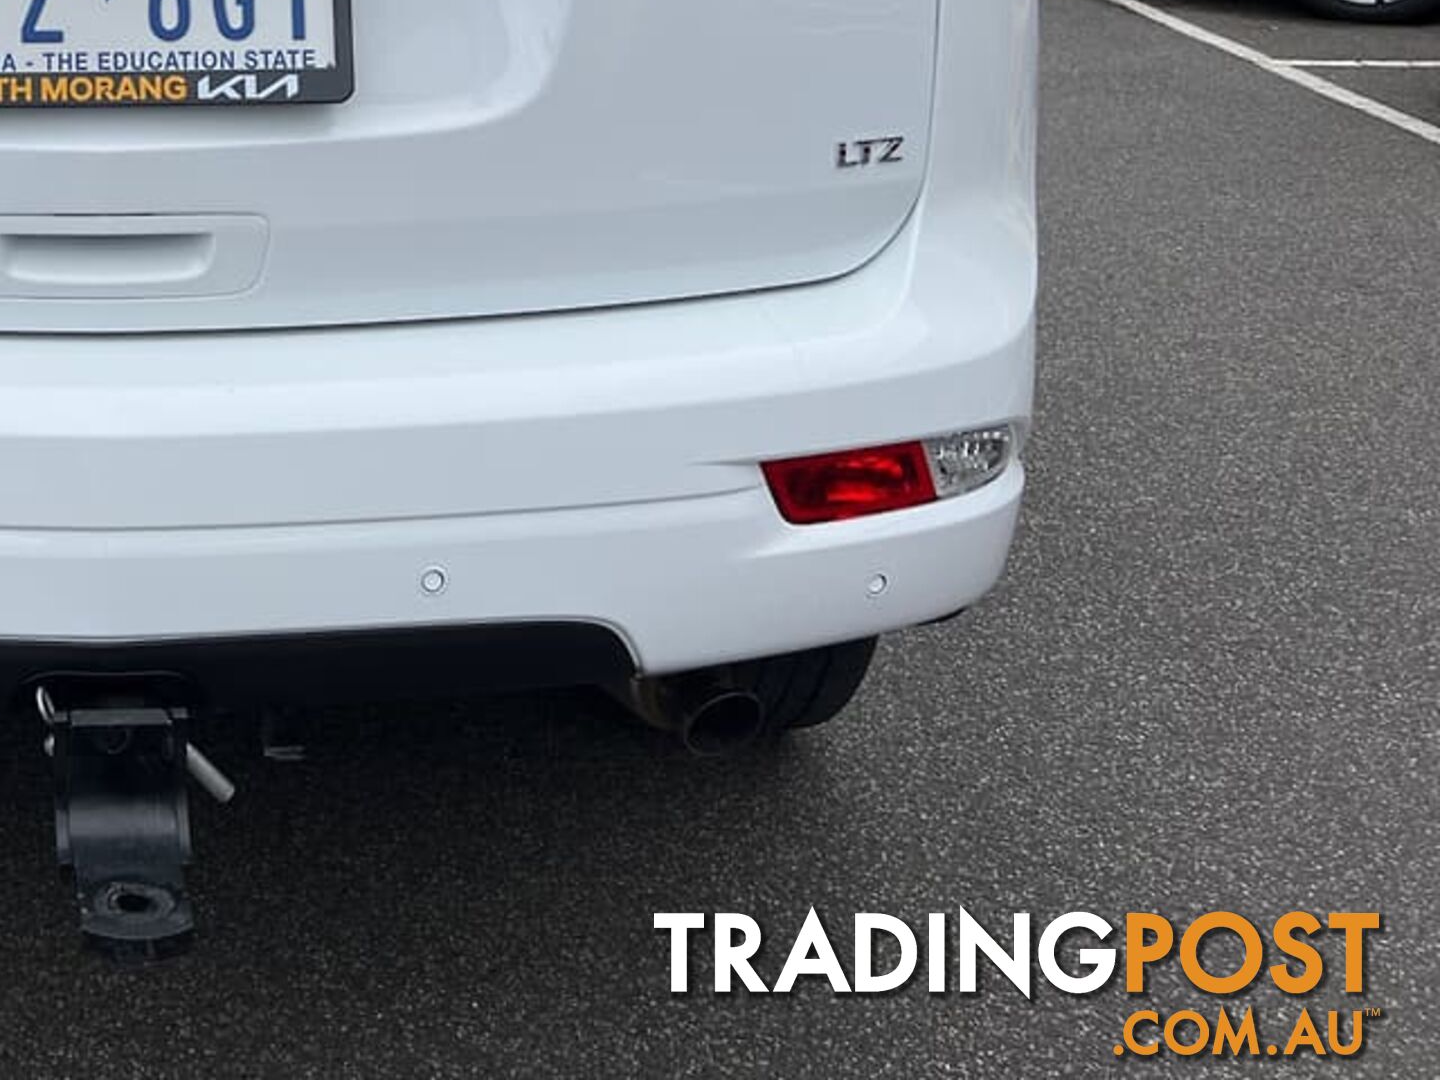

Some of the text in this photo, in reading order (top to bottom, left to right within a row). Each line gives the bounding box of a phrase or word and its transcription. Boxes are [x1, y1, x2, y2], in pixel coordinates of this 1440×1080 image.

[45, 52, 90, 72] THE
[98, 50, 241, 72] EDUCATION
[244, 49, 316, 70] STATE
[40, 74, 188, 102] MORANG
[837, 136, 904, 169] LTZ
